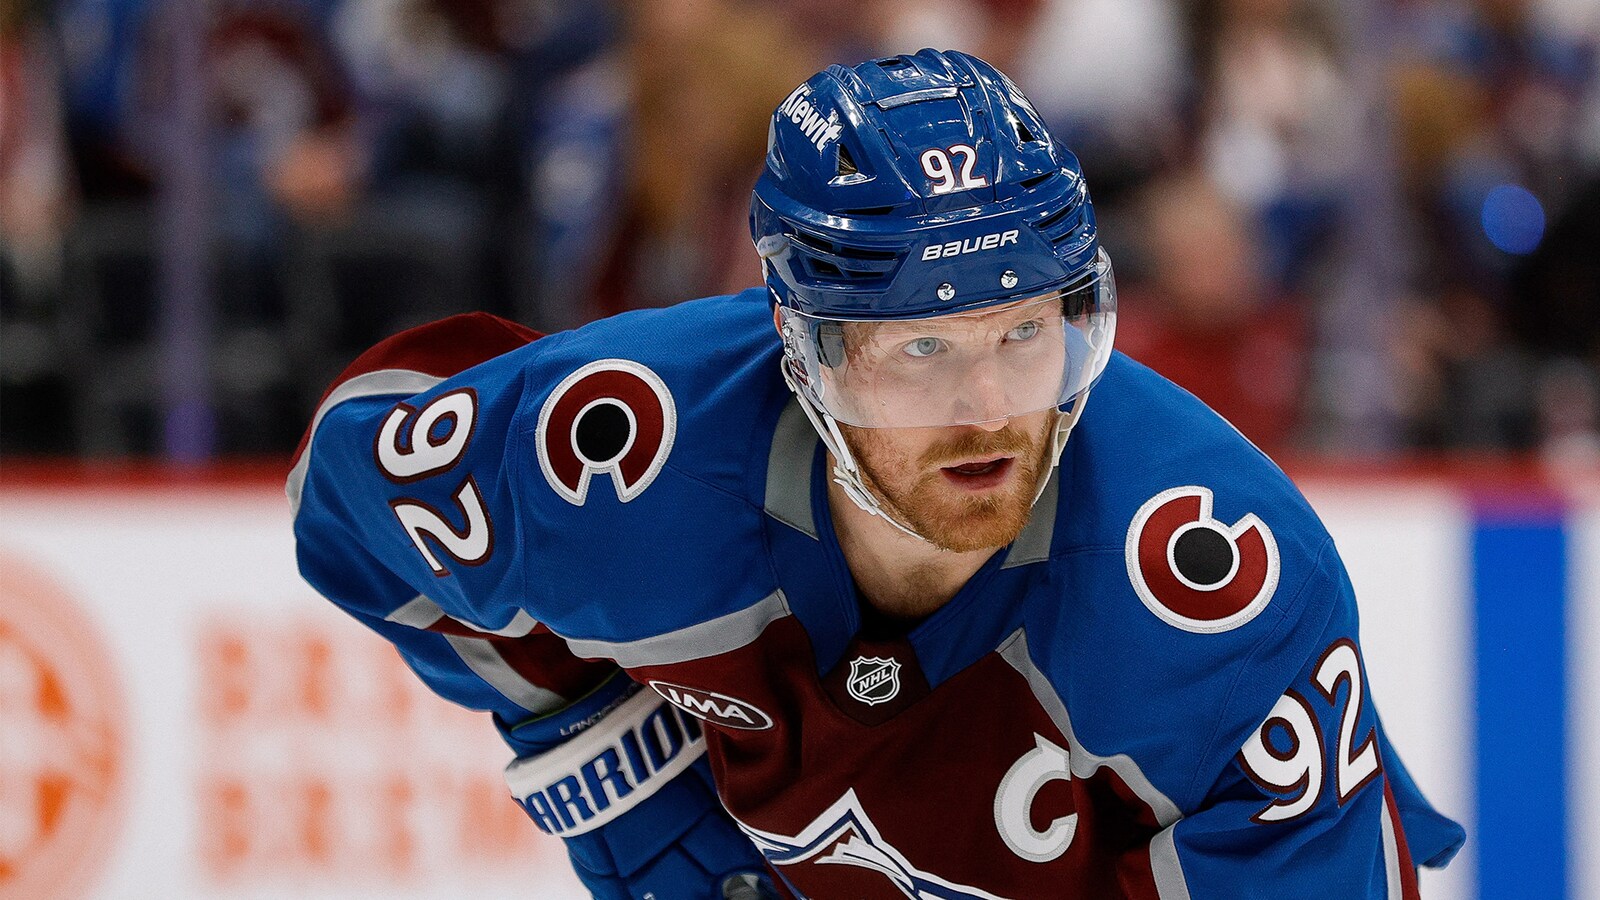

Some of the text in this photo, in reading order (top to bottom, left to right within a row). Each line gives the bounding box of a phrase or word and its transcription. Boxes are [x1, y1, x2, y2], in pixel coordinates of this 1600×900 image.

[779, 83, 843, 153] Kiewit
[919, 143, 987, 196] 92
[921, 229, 1020, 262] BAUER
[373, 386, 494, 578] 92
[667, 688, 754, 724] IMA
[858, 668, 891, 691] NHL
[1239, 638, 1383, 824] 92
[511, 703, 703, 835] ARRIO
[993, 731, 1079, 864] C
